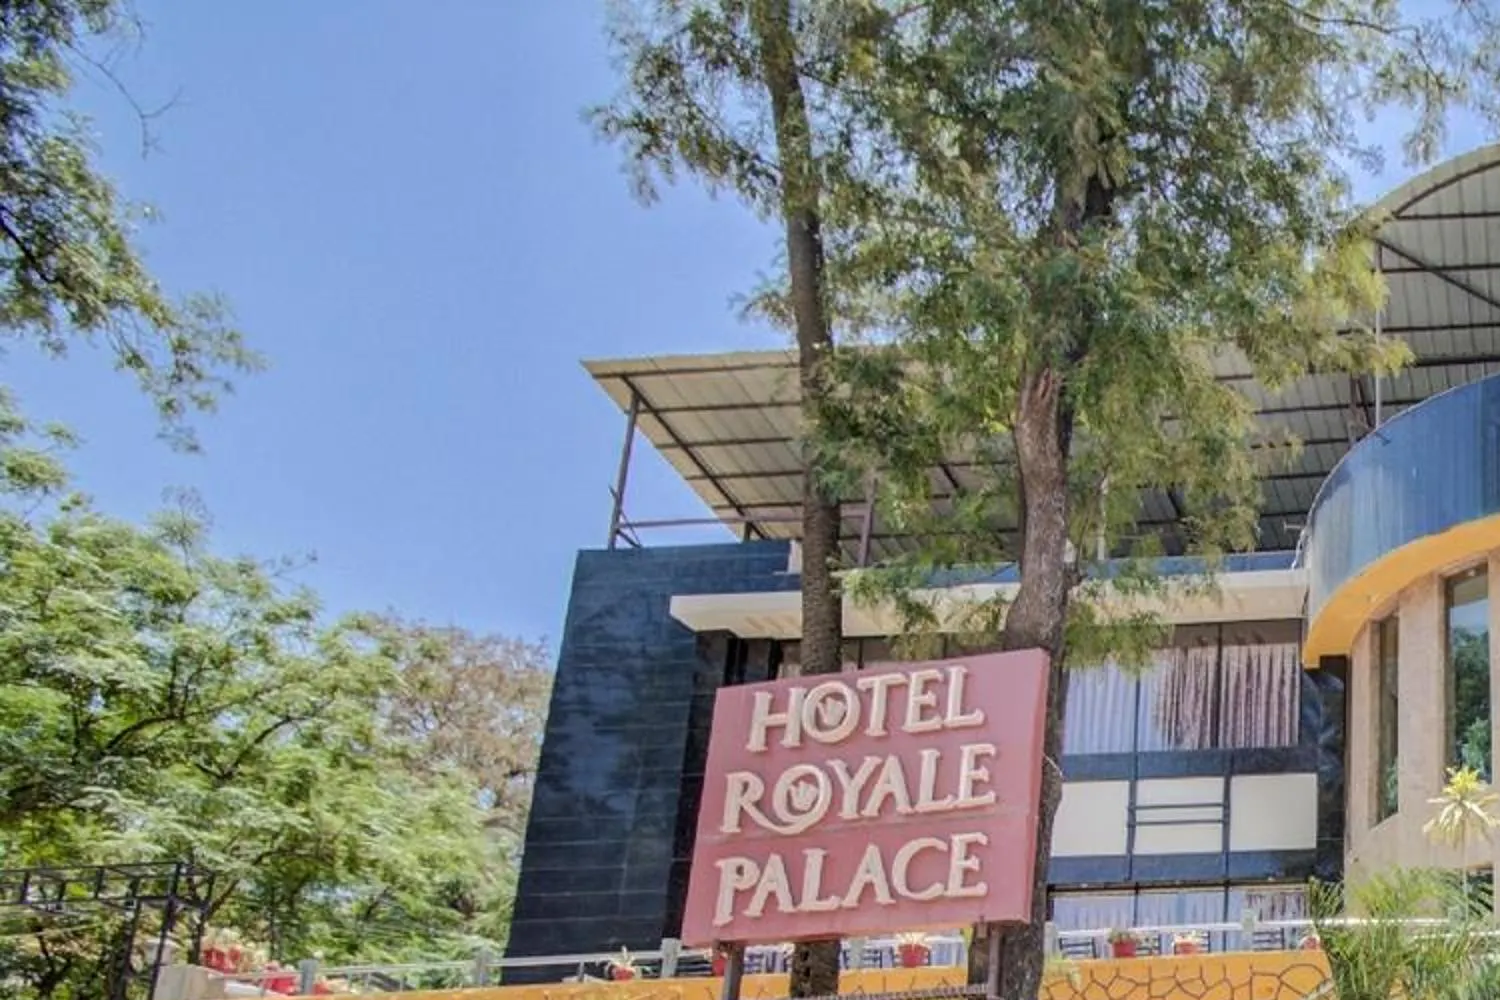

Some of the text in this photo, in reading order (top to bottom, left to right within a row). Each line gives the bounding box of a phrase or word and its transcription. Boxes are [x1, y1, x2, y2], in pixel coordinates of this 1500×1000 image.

[745, 666, 986, 752] HOTEL
[721, 743, 997, 835] ROYALE
[713, 832, 989, 927] PALACE
